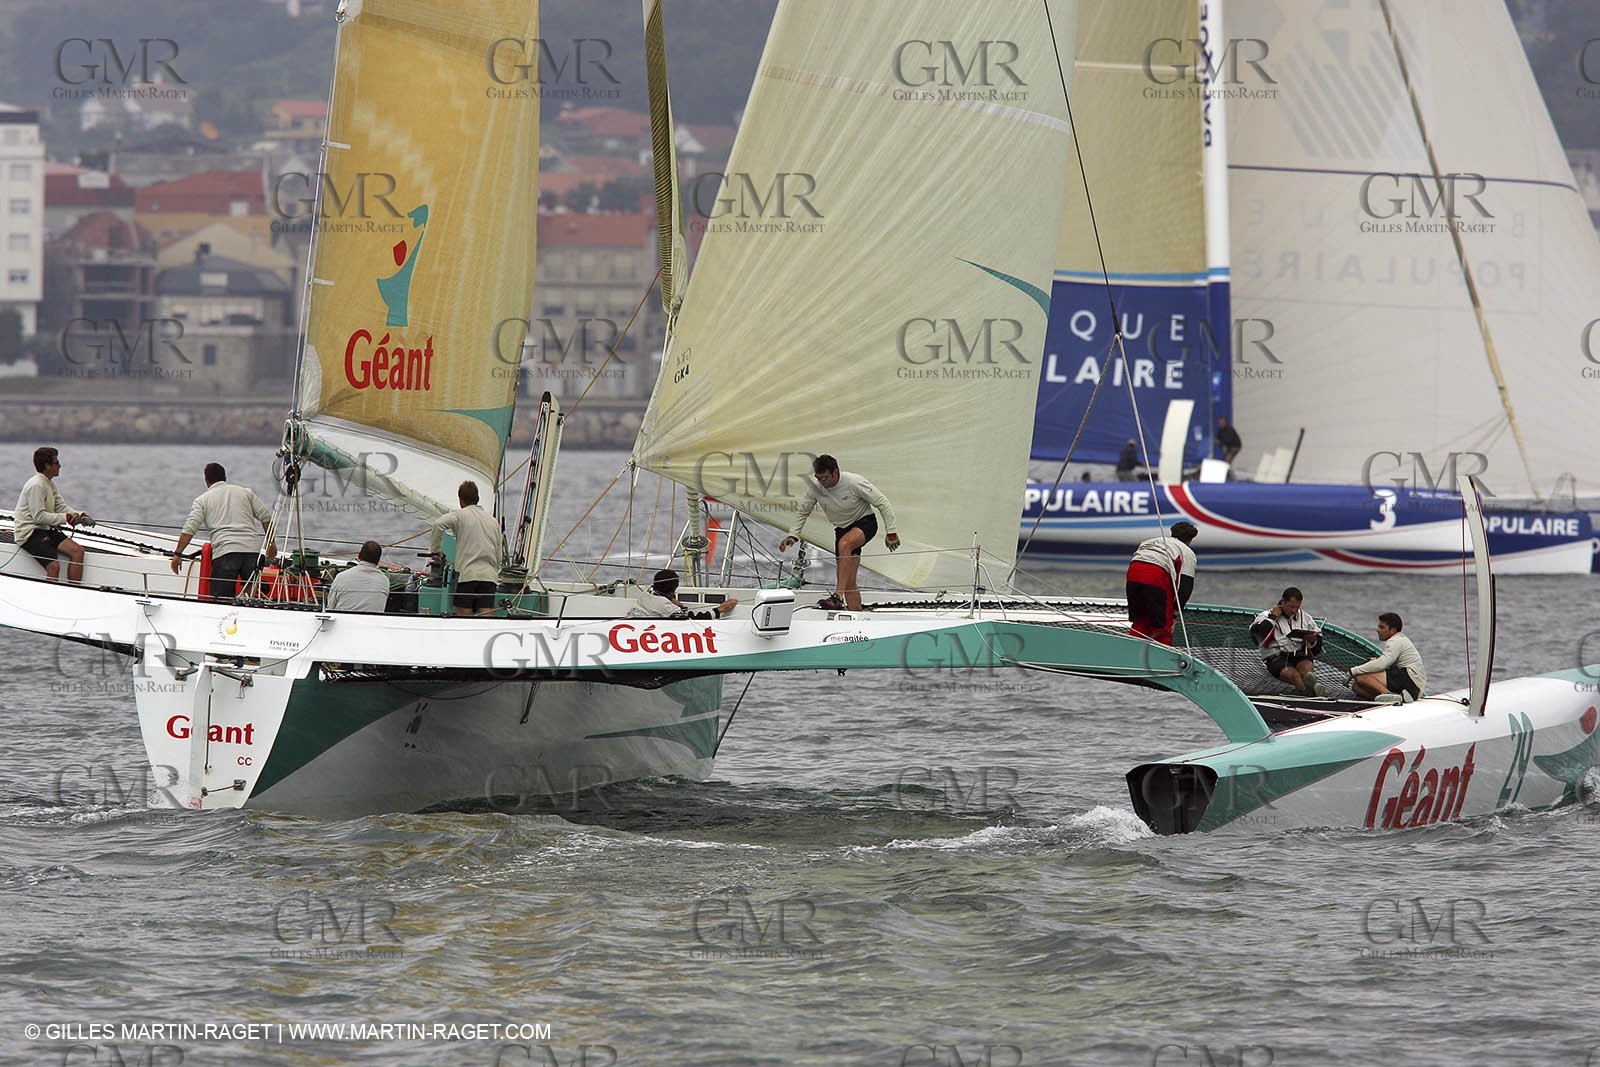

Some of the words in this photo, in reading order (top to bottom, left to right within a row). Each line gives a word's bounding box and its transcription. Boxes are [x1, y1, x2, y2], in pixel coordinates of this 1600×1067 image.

[1070, 309, 1184, 342] QUE
[345, 329, 434, 391] Géant
[1046, 354, 1184, 389] LAIRE
[1024, 488, 1149, 514] PULAIRE
[1370, 489, 1397, 531] 3
[609, 624, 718, 654] Géant
[166, 715, 255, 745] Gant
[237, 757, 253, 766] CC
[1364, 741, 1476, 829] Géant
